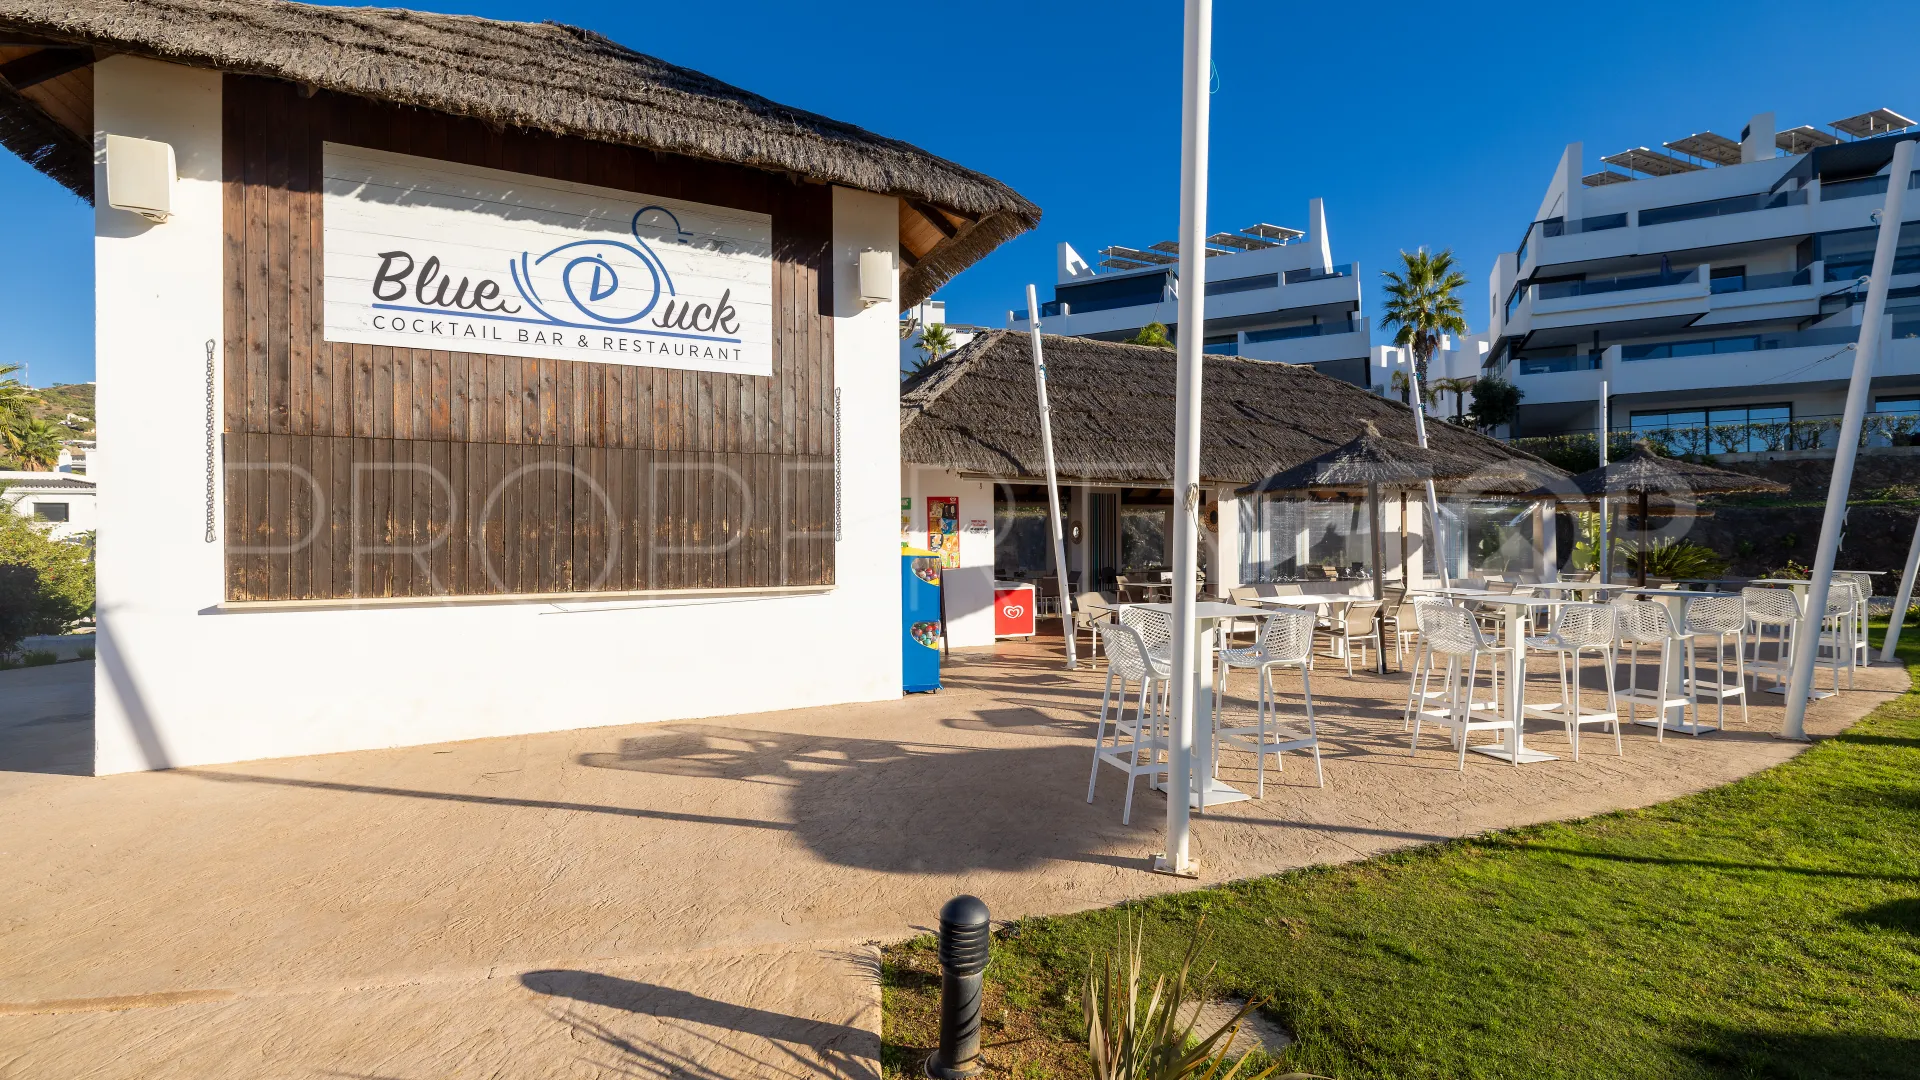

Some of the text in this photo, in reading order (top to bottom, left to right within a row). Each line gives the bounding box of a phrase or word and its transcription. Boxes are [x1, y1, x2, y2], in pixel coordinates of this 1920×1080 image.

[373, 250, 521, 314] Blue
[373, 315, 741, 361] COCKTAIL BAR & RESTAURANT
